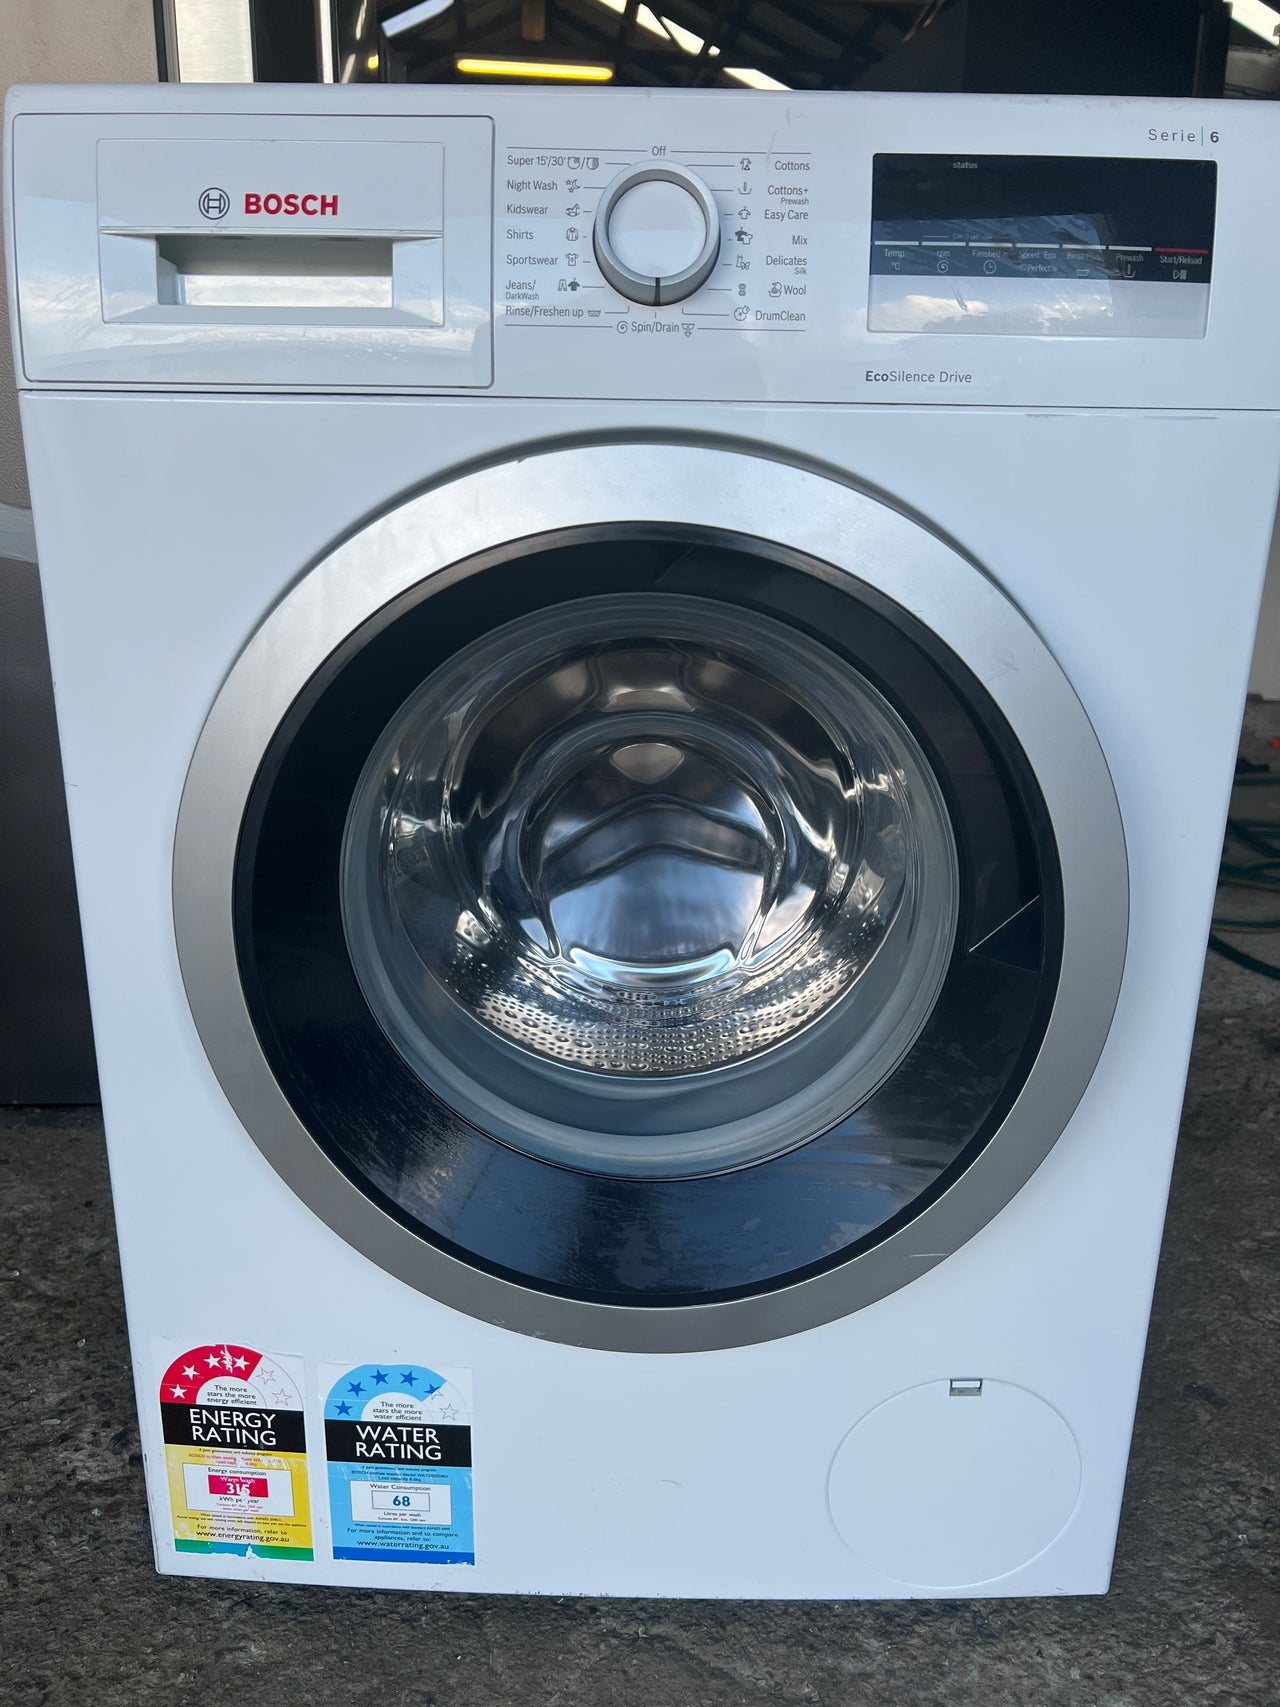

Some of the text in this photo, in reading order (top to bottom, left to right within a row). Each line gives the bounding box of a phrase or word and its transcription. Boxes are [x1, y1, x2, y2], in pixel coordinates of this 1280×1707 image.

[1148, 128, 1220, 143] Serie 6
[651, 145, 667, 156] Off
[506, 155, 534, 167] Super
[774, 160, 810, 171] Cottons
[507, 180, 558, 192] Night Wash
[767, 185, 809, 196] Cottons+
[244, 193, 339, 216] BOSCH
[780, 197, 809, 206] Prewash
[506, 204, 548, 215] Kidswear
[764, 209, 809, 222] Easy Care
[506, 228, 534, 240] Shirts
[792, 235, 808, 246] Mix
[506, 254, 559, 267] Sportswear
[765, 255, 808, 267] Delicates
[936, 251, 951, 260] rpm
[1159, 255, 1203, 265] Start/Reload
[794, 267, 808, 275] Silk
[505, 280, 537, 292] Jeans/
[783, 284, 807, 296] Wool
[505, 292, 540, 301] DarkWash
[505, 305, 584, 319] Rinse/Freshen up
[755, 310, 806, 322] DrumClean
[631, 321, 680, 334] Spin/Drain
[865, 370, 972, 384] EcoSilence Drive
[214, 1384, 228, 1392] The
[225, 1391, 236, 1399] the
[381, 1401, 394, 1409] The
[391, 1407, 402, 1415] the
[189, 1408, 276, 1430] ENERGY
[192, 1425, 277, 1446] RATING
[356, 1425, 440, 1444] WATER
[355, 1441, 442, 1461] RATING
[208, 1467, 267, 1477] Energy consumption
[391, 1484, 432, 1492] Consumption
[392, 1495, 411, 1508] 68
[196, 1530, 290, 1543] www.energyrating.gov.au
[226, 1526, 263, 1536] information,
[377, 1529, 410, 1537] information
[357, 1540, 450, 1551] www.waterrating.gov.au
